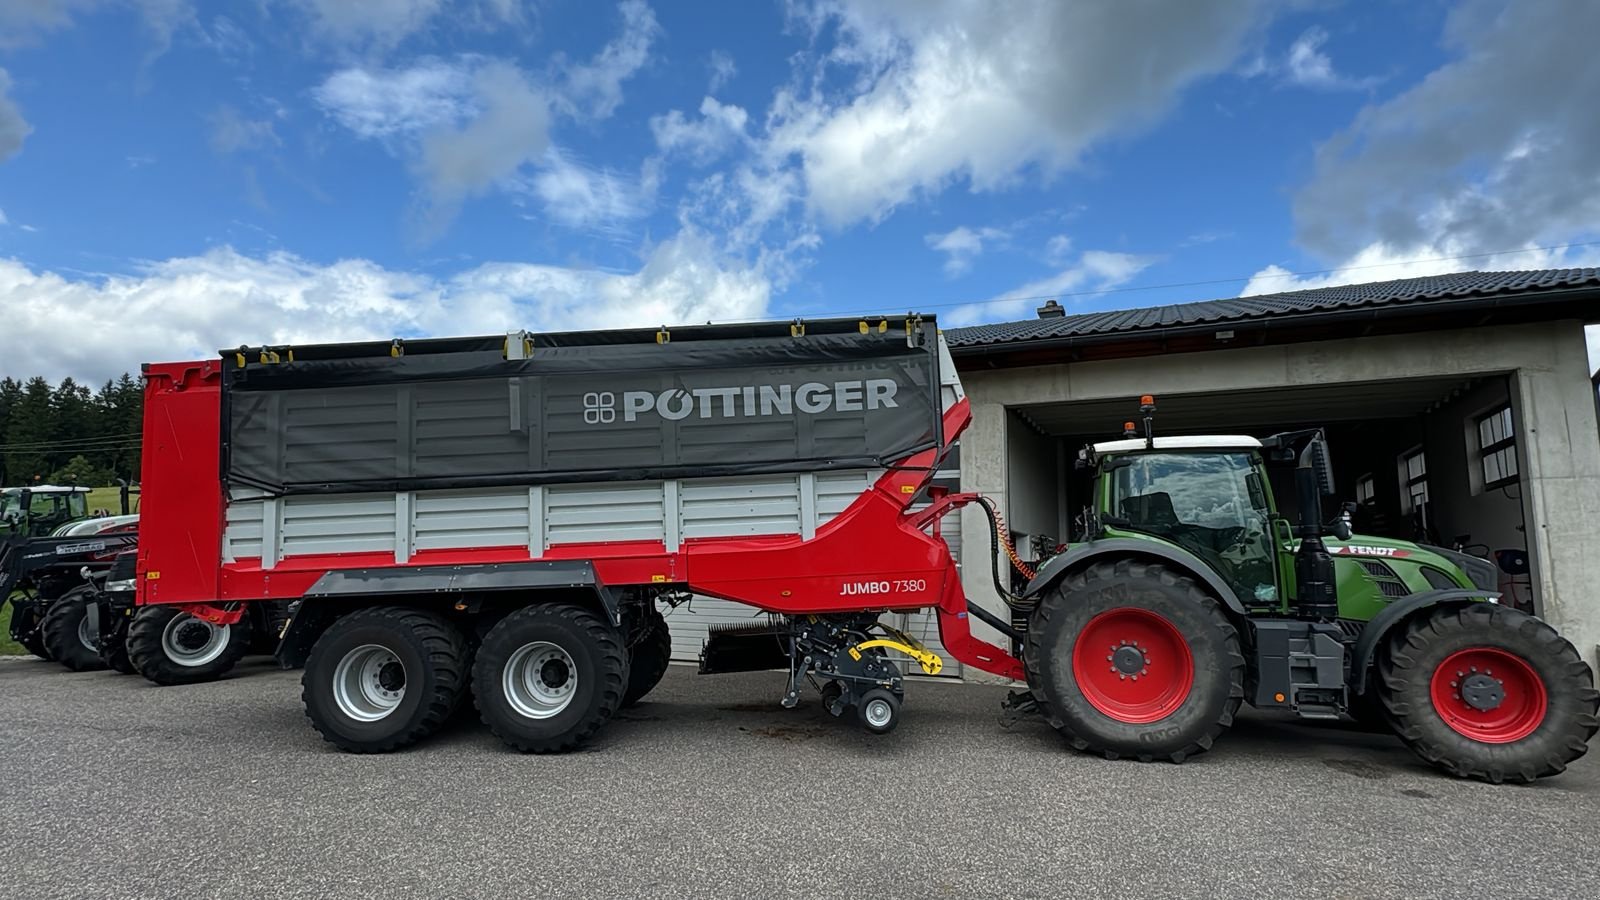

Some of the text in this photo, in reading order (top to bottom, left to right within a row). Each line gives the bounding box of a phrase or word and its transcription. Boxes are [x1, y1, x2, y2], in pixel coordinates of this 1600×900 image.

[1347, 545, 1397, 556] FENDT
[840, 579, 926, 595] JUMBO 7380
